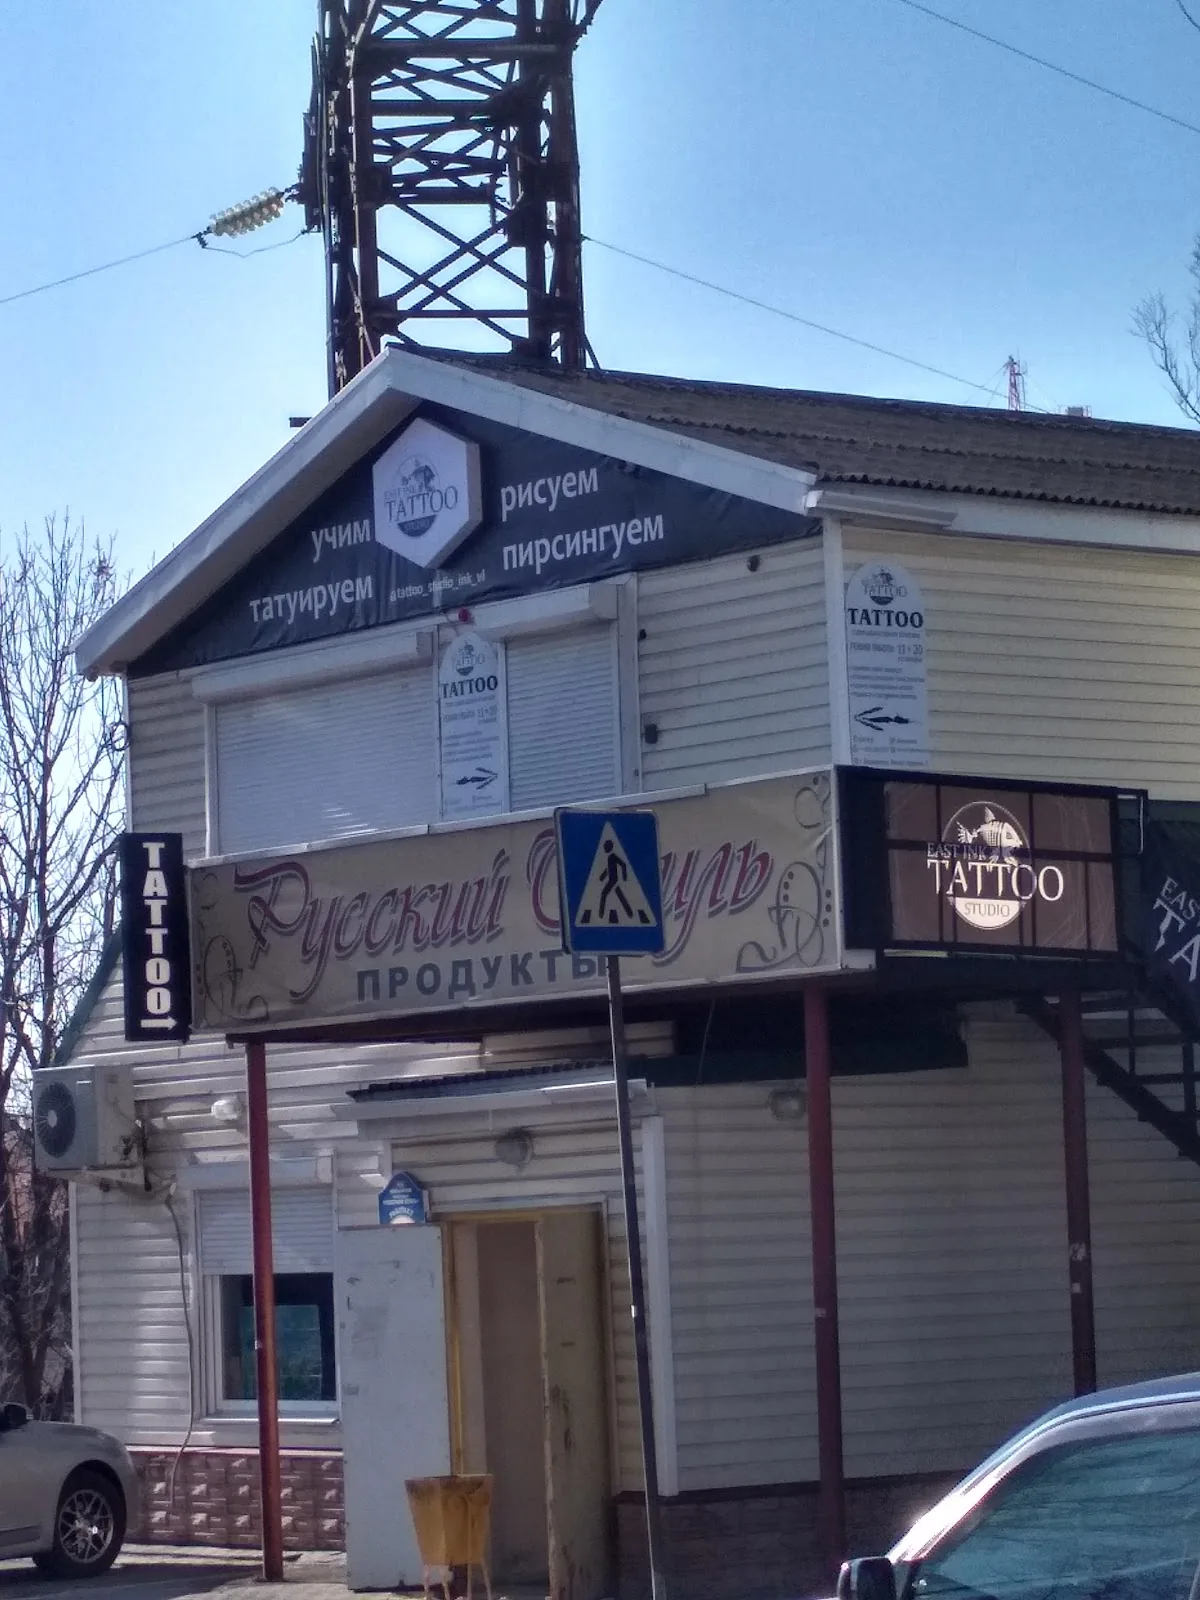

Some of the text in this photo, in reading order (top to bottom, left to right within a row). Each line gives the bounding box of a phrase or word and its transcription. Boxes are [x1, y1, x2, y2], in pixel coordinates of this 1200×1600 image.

[385, 485, 458, 522] TATTOO
[501, 467, 598, 522] рисуем
[311, 519, 371, 563] учим
[503, 514, 664, 574] пирсингуем
[249, 575, 373, 625] татуируем
[847, 607, 924, 628] TATTOO
[442, 675, 499, 699] TATTOO
[927, 842, 988, 860] EAST INK
[926, 859, 1064, 901] TATTOO
[142, 842, 172, 1015] TATTOO
[234, 848, 510, 1004] Русский
[964, 903, 1010, 918] STUDIO
